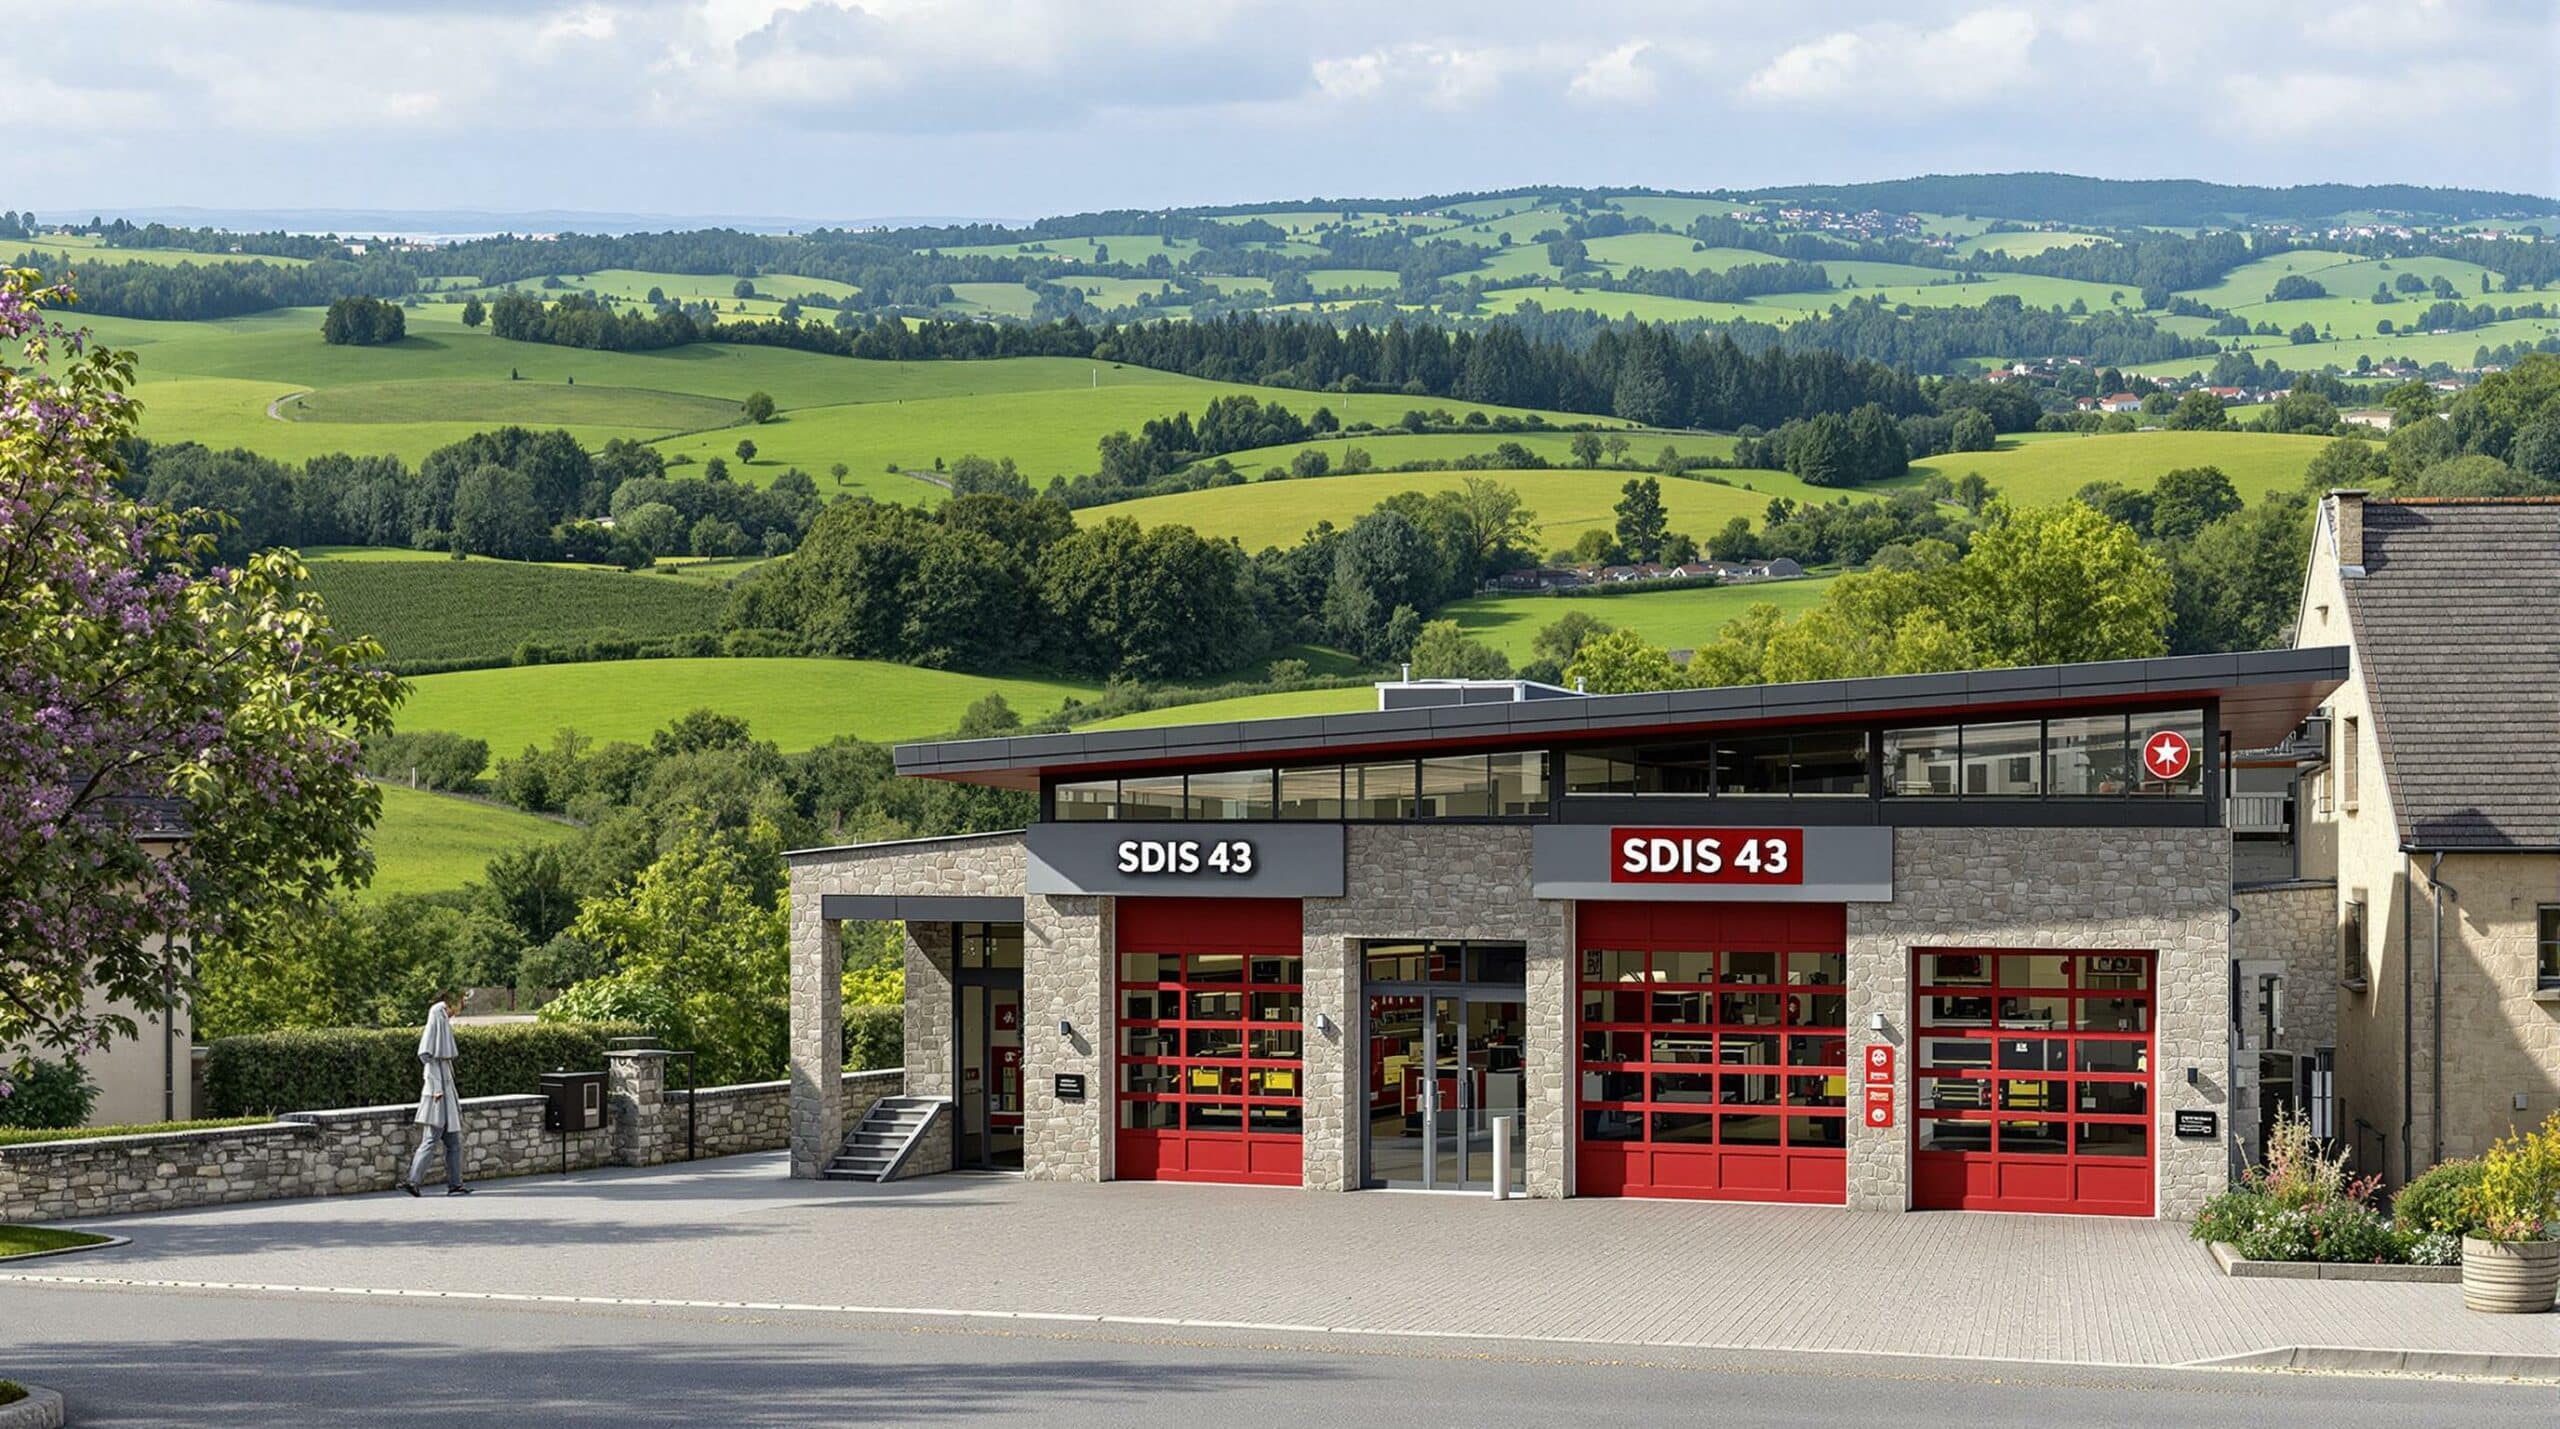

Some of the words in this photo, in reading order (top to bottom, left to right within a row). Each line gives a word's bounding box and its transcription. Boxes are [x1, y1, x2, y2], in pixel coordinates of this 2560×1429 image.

[1118, 840, 1200, 873] SDIS
[1207, 841, 1252, 874] 43
[1622, 837, 1722, 873] SDIS
[1734, 838, 1788, 874] 43
